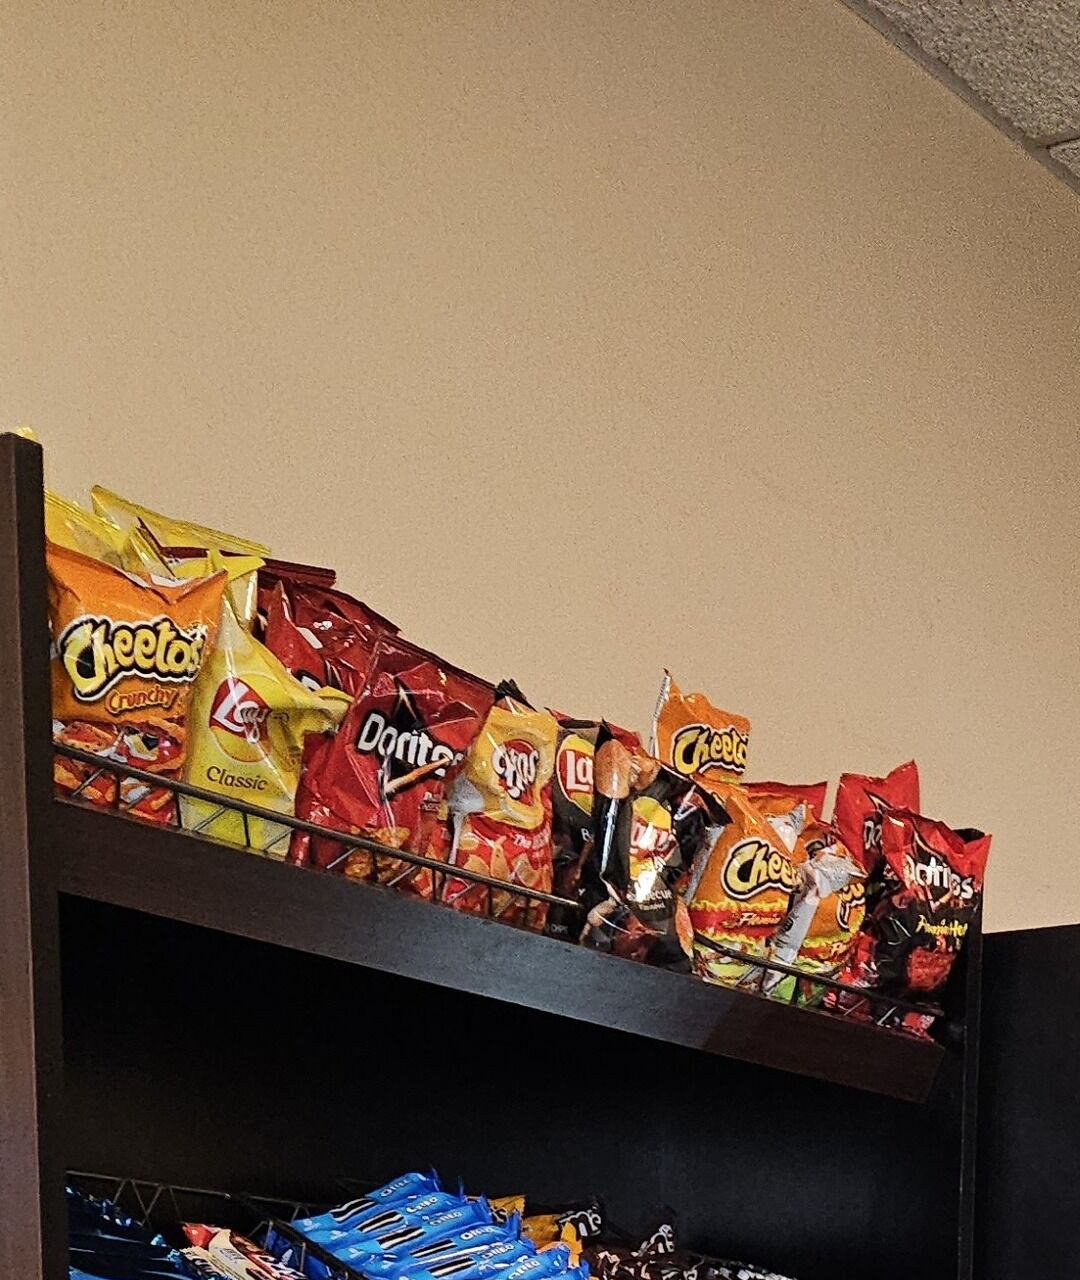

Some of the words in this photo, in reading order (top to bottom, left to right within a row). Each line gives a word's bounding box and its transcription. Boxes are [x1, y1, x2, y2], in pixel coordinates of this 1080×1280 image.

[62, 618, 206, 693] Cheetos
[105, 687, 180, 714] Crunchy
[206, 766, 268, 791] Classic
